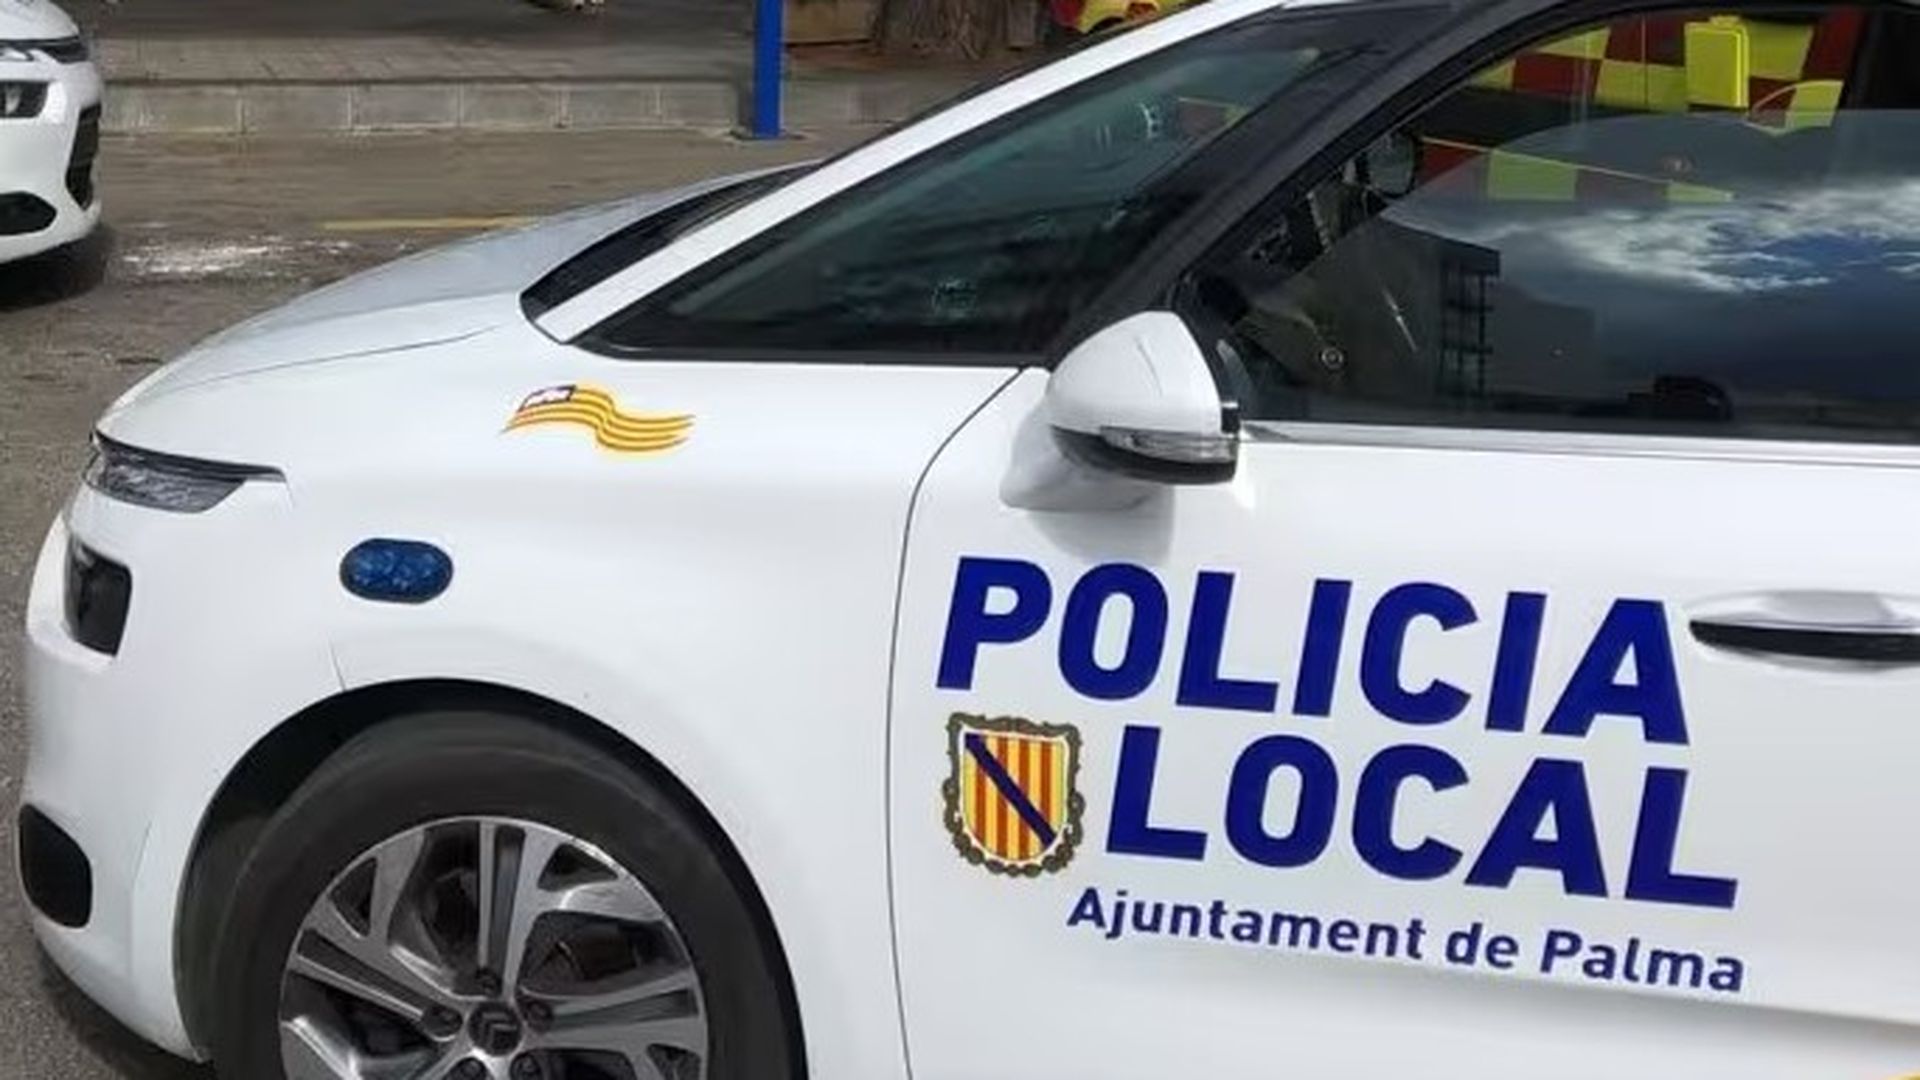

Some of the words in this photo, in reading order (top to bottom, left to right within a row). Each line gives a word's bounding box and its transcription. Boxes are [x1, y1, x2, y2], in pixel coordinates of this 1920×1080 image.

[936, 556, 1690, 745] POLICIA
[1106, 725, 1738, 908] LOCAL
[1067, 887, 1425, 960] Ajuntament
[1446, 922, 1519, 970] de
[1541, 929, 1744, 992] Palma
